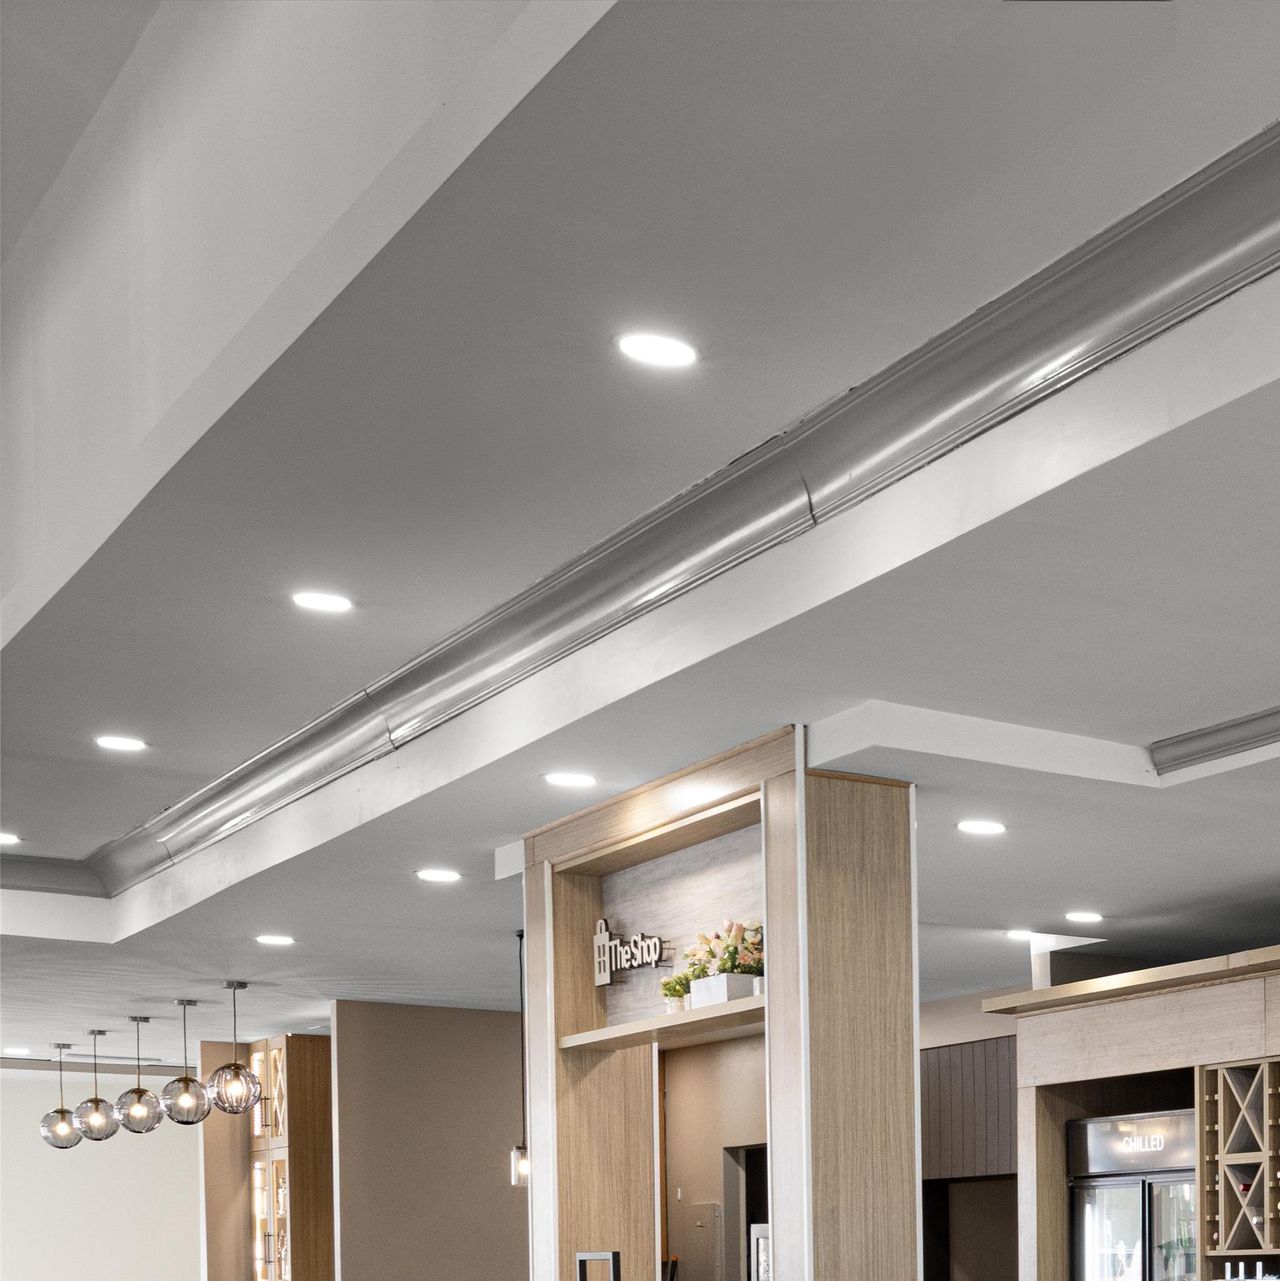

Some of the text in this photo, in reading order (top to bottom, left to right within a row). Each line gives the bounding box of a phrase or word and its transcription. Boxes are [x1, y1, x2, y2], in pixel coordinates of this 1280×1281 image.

[608, 933, 661, 972] The Shop
[1122, 1134, 1165, 1153] CHILLED
